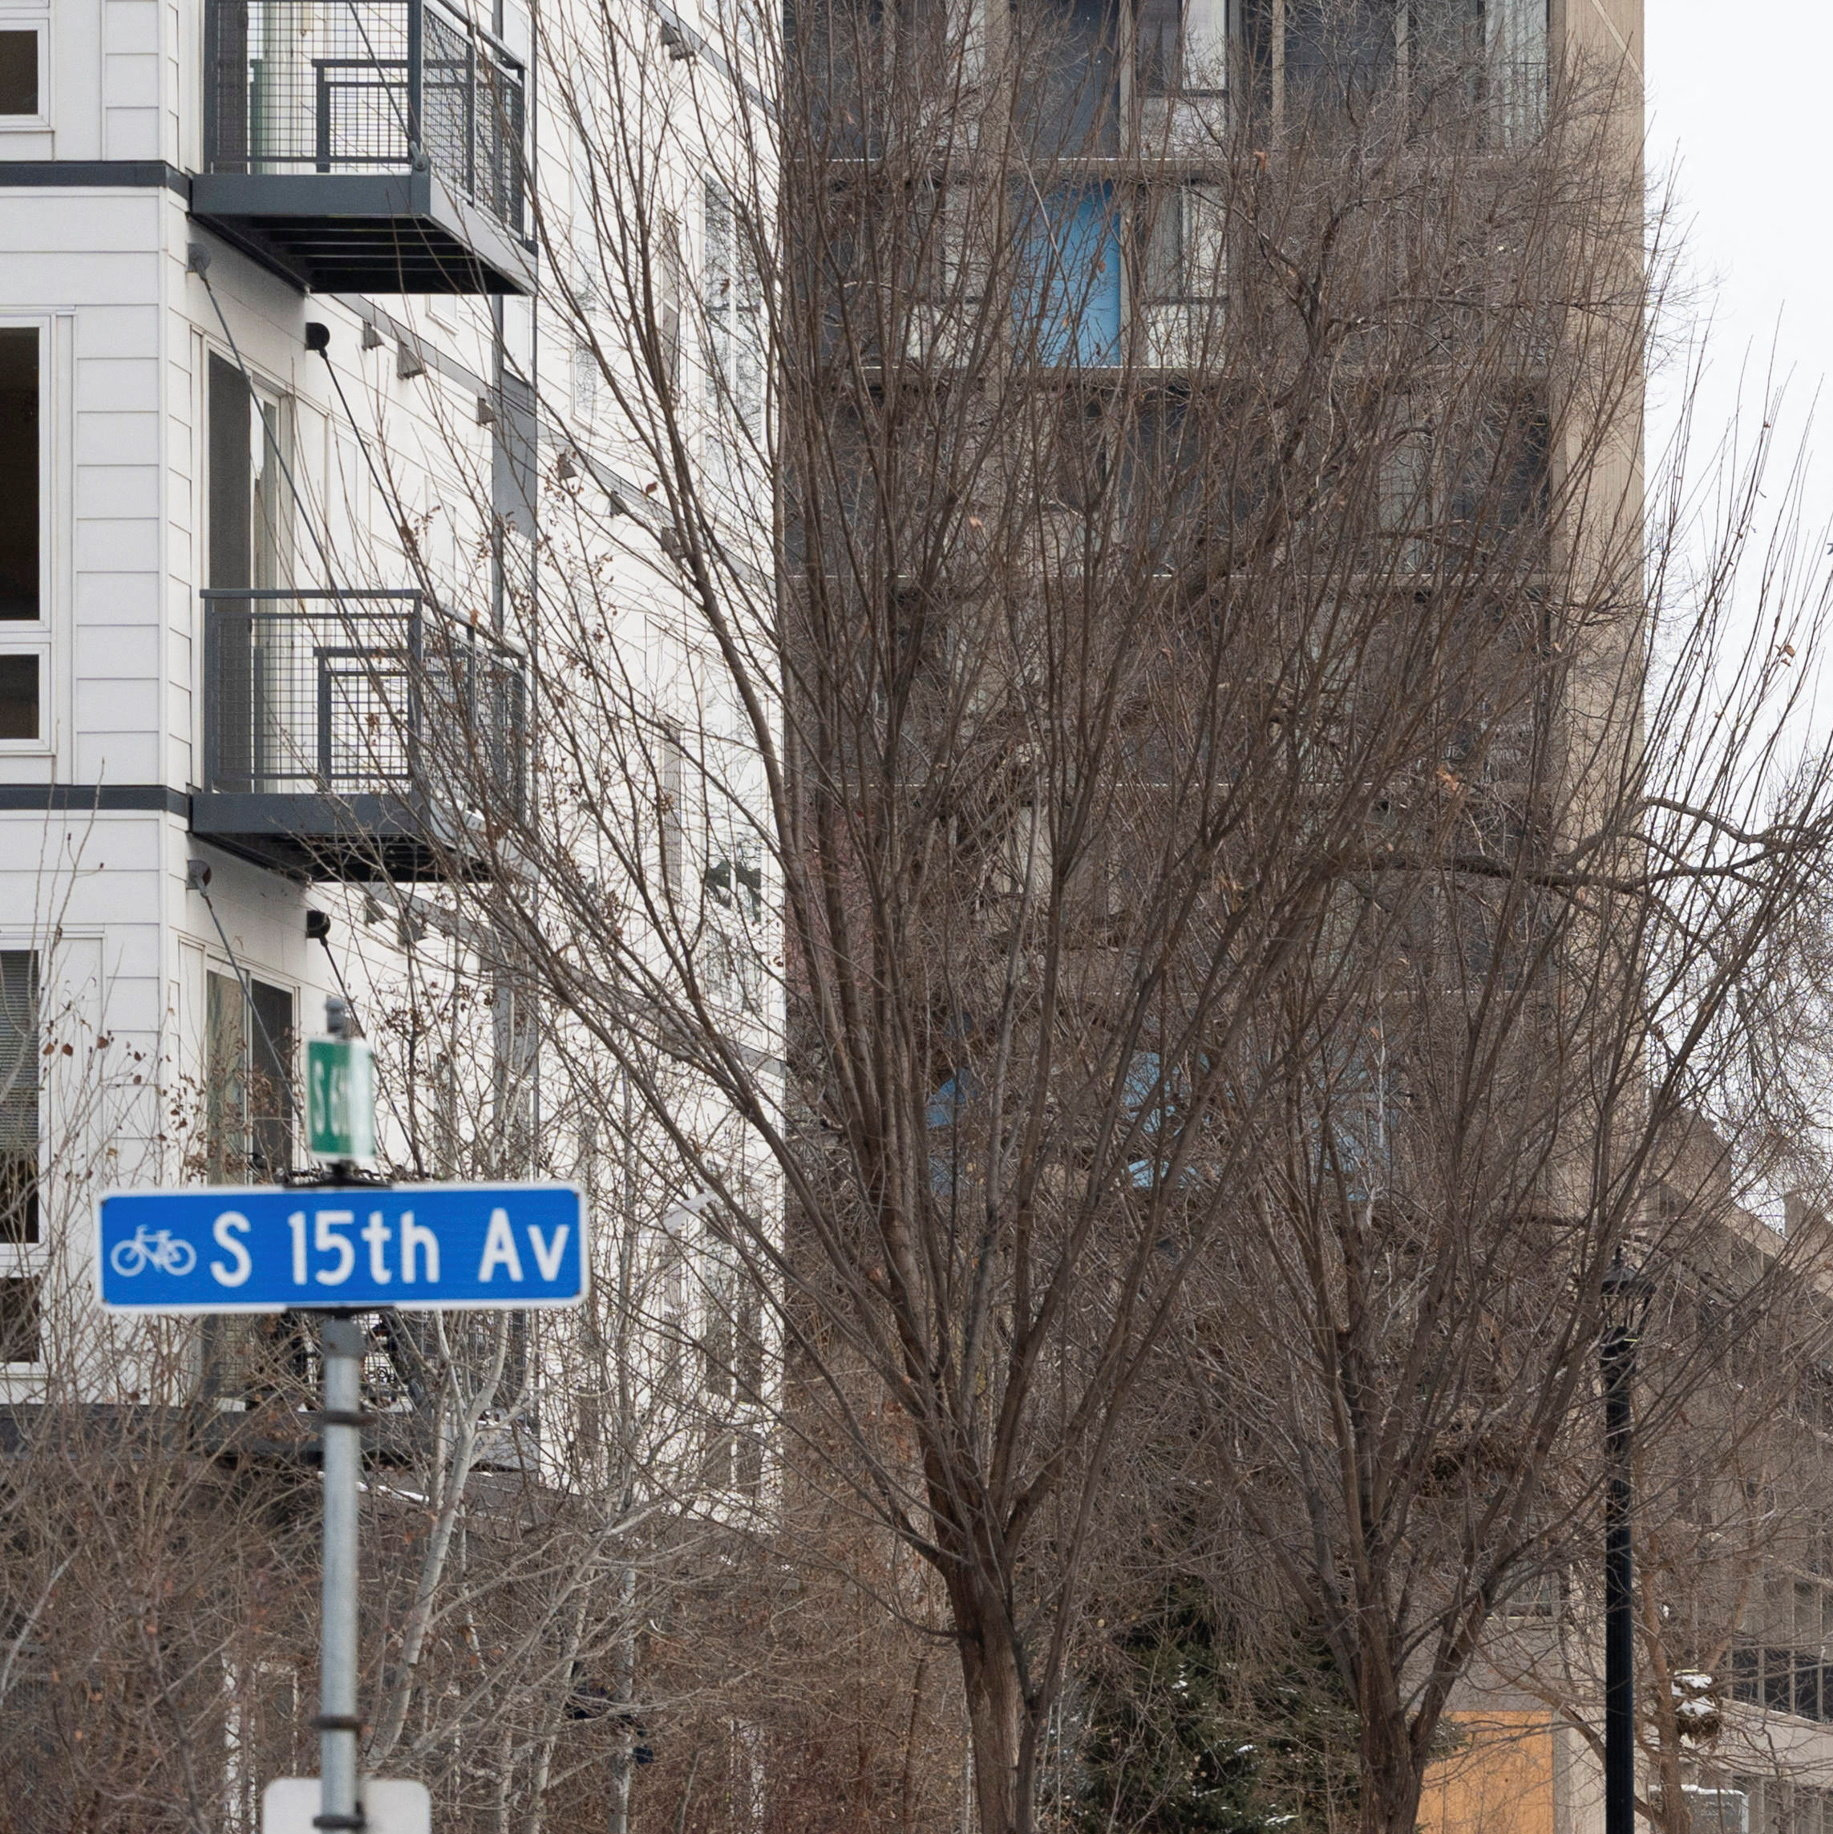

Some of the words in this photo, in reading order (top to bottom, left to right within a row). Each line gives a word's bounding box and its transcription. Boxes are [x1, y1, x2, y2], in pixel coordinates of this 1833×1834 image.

[210, 1210, 252, 1288] S
[288, 1209, 440, 1286] 15th
[477, 1207, 570, 1282] Av
